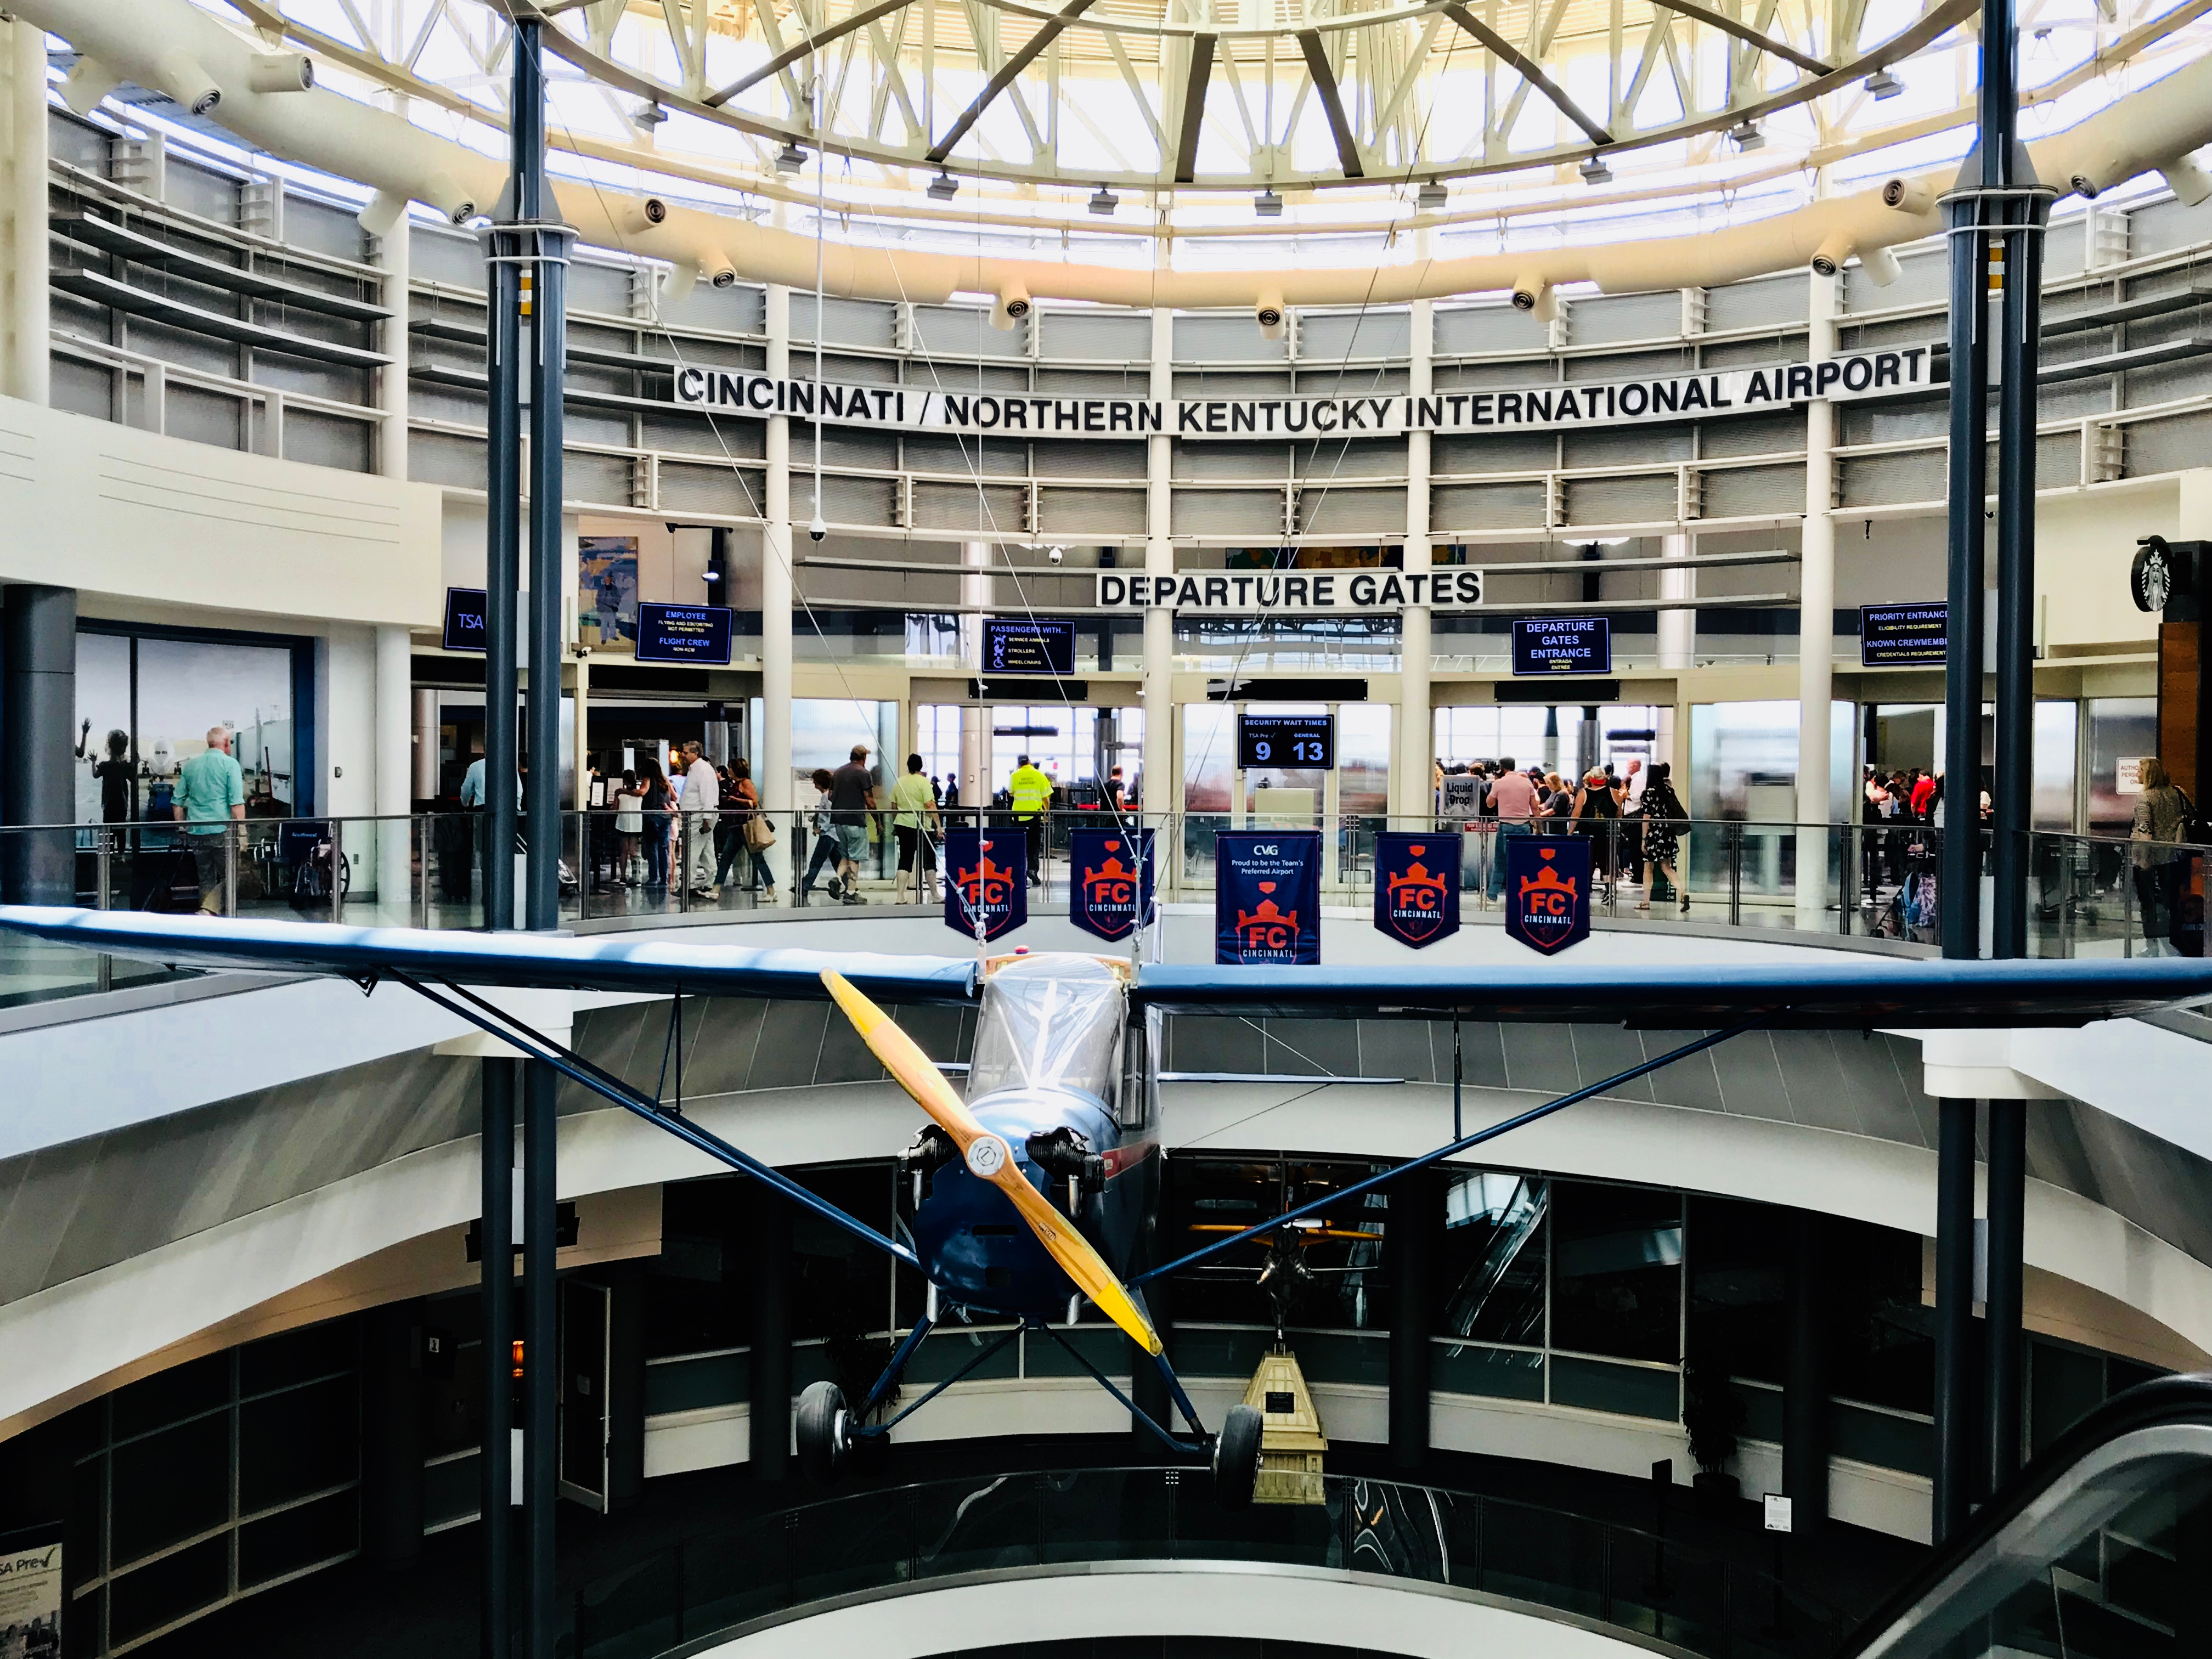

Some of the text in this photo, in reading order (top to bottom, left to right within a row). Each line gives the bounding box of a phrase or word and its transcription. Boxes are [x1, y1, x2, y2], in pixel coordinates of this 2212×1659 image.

[678, 347, 1926, 432] CINCINNATI / NORTHERN KENTUCKY INTERNATIONAL AIRPORT
[1102, 572, 1481, 606] DEPARTURE GATES
[458, 613, 484, 629] TSA
[666, 611, 707, 619] EMPLOYEE
[1869, 612, 1905, 621] PRIORITY
[1527, 622, 1594, 633] DEPARTURE
[1542, 635, 1579, 645] GATES
[1531, 648, 1591, 658] ENTRANCE
[1256, 742, 1271, 760] 9
[1293, 742, 1323, 760] 13
[1446, 782, 1473, 794] Liquid
[1449, 794, 1470, 806] Drop
[1254, 845, 1278, 855] CVG
[969, 883, 1003, 904] FC
[1095, 883, 1130, 903] FC
[1400, 889, 1435, 910] FC
[1531, 893, 1566, 915] FC
[963, 904, 1008, 912] CNCNNATI
[1089, 904, 1136, 912] CINCINNATI
[1393, 910, 1441, 918] CINCINNATI
[1524, 915, 1571, 924] CINCINNATI
[1249, 927, 1286, 948] FC
[1243, 949, 1294, 957] CINCINNATI
